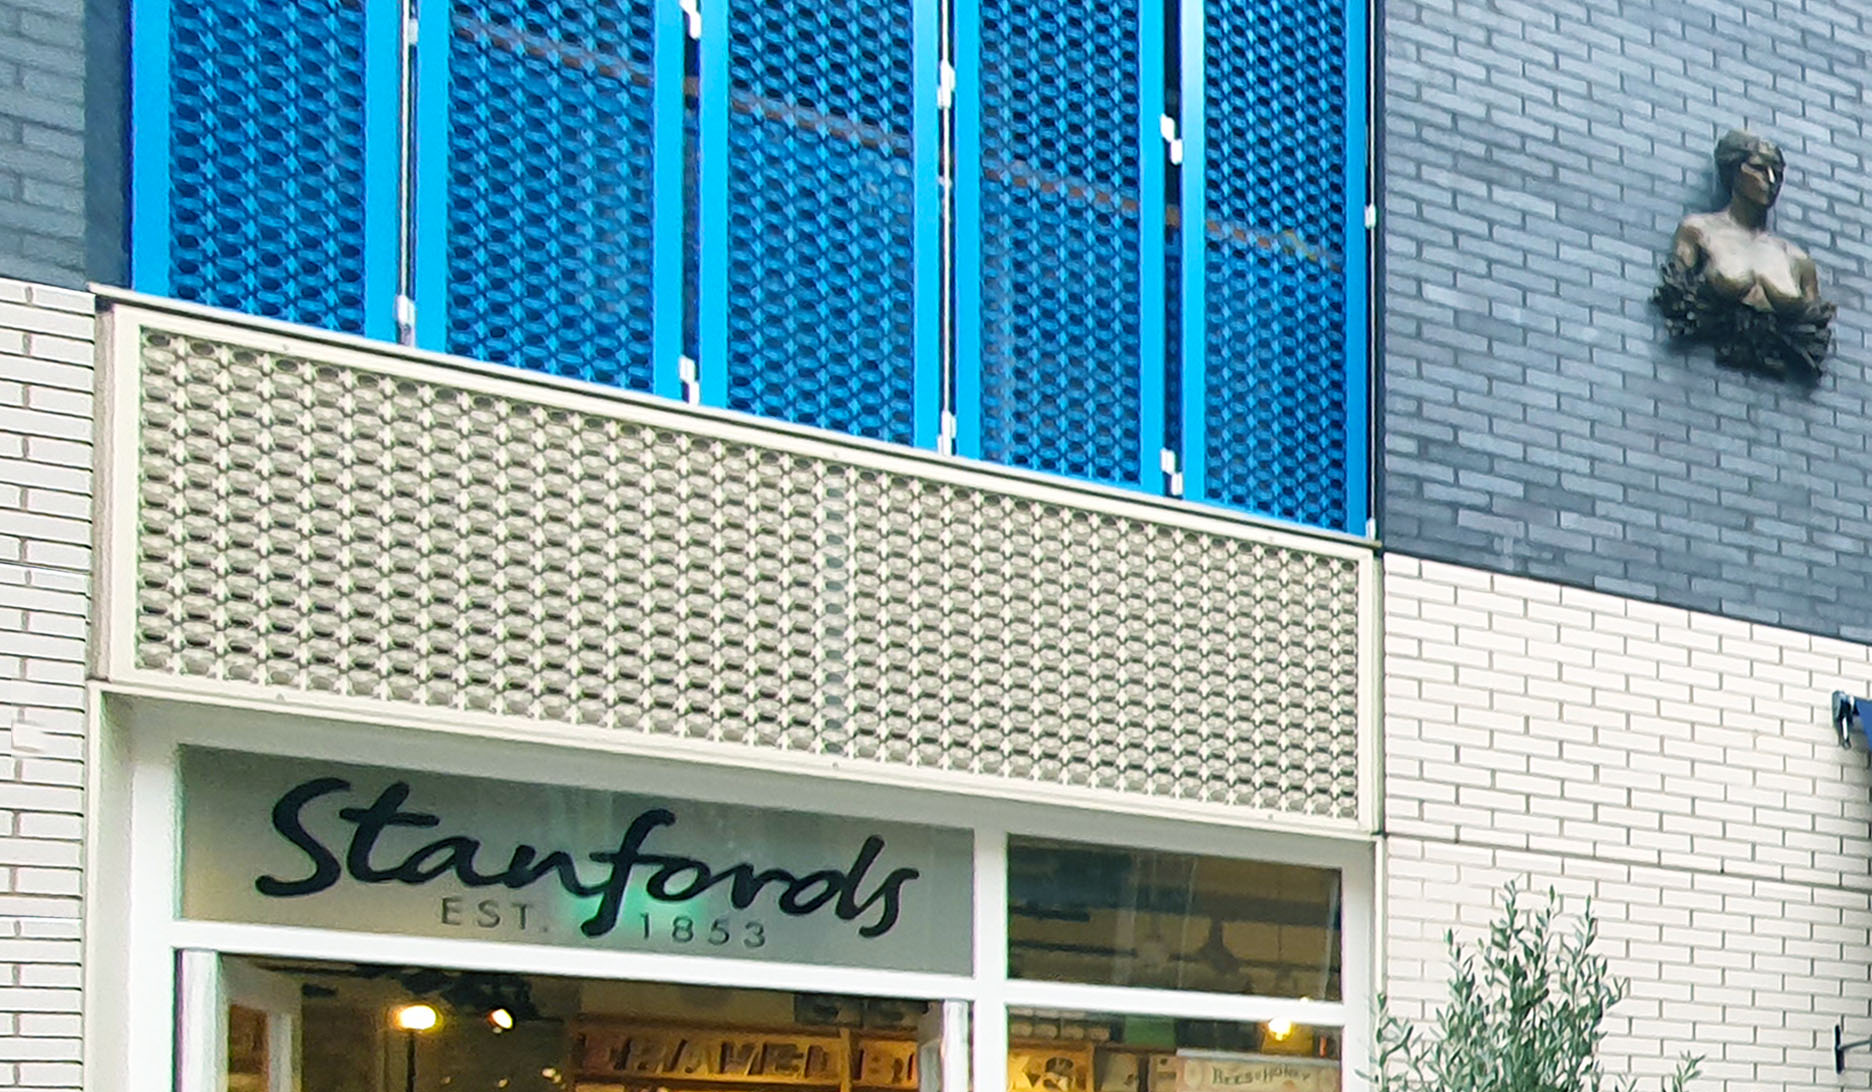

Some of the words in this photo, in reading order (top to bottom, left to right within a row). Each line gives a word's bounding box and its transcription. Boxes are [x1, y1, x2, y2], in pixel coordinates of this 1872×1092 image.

[256, 777, 920, 938] Stanfords
[441, 897, 549, 934] EST.
[641, 911, 767, 948] 1853
